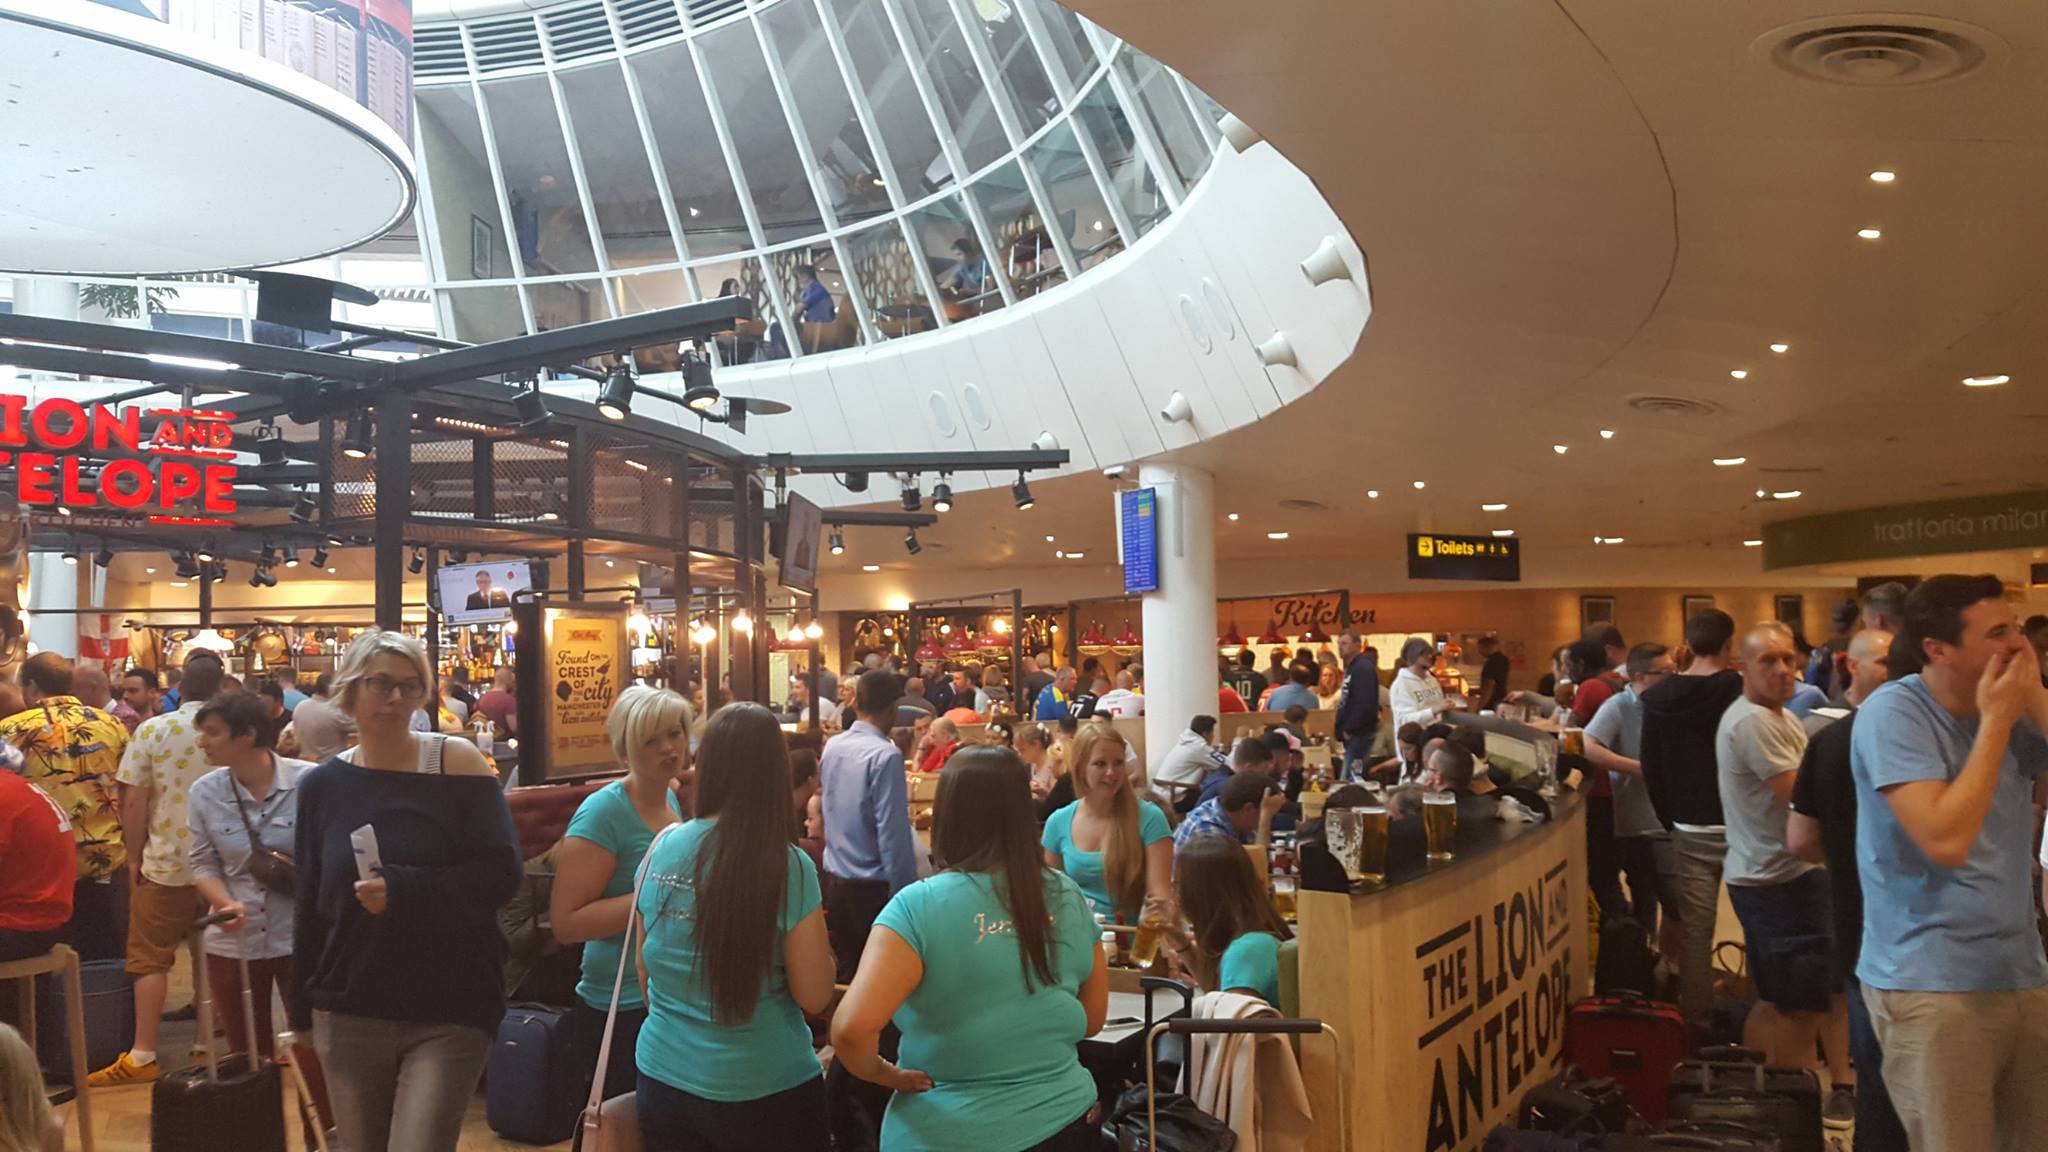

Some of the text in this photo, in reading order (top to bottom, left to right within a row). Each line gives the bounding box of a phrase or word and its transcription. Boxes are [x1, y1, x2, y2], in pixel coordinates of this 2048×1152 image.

[152, 419, 234, 448] AND
[1874, 513, 1975, 541] trattoria
[1435, 540, 1474, 556] Toilets
[555, 650, 591, 665] Found
[558, 666, 596, 678] CREST
[573, 679, 586, 689] OF
[583, 676, 613, 710] city
[1423, 945, 1467, 1020] THE
[1474, 878, 1546, 1011] LION
